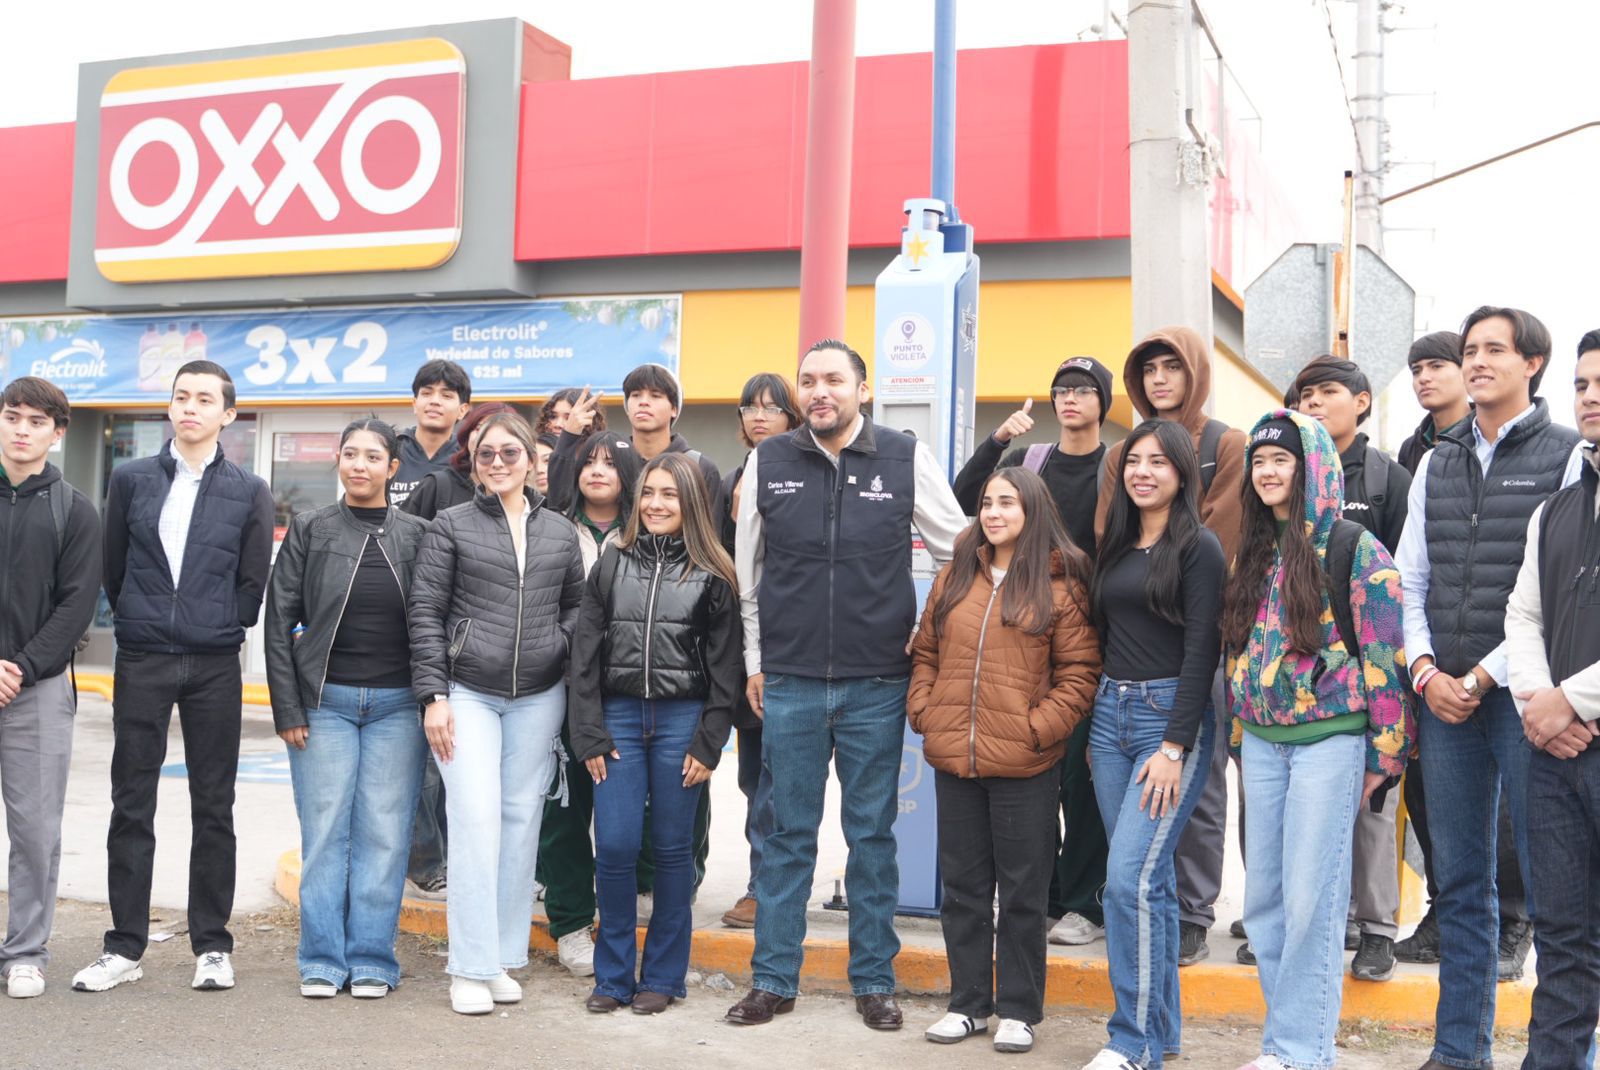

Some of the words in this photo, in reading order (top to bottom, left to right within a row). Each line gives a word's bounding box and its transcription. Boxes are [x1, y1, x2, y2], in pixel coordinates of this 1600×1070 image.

[109, 94, 442, 246] OXXO
[244, 321, 388, 385] 3x2
[426, 347, 489, 361] Variedad
[492, 344, 510, 360] de
[513, 343, 574, 359] Sabores
[893, 344, 923, 352] PUNTO
[890, 352, 927, 361] VIOLETA
[30, 359, 108, 378] Electrolit
[472, 365, 500, 379] 625
[502, 364, 523, 379] ml
[390, 482, 408, 491] LEVI
[1508, 479, 1536, 487] Columbia
